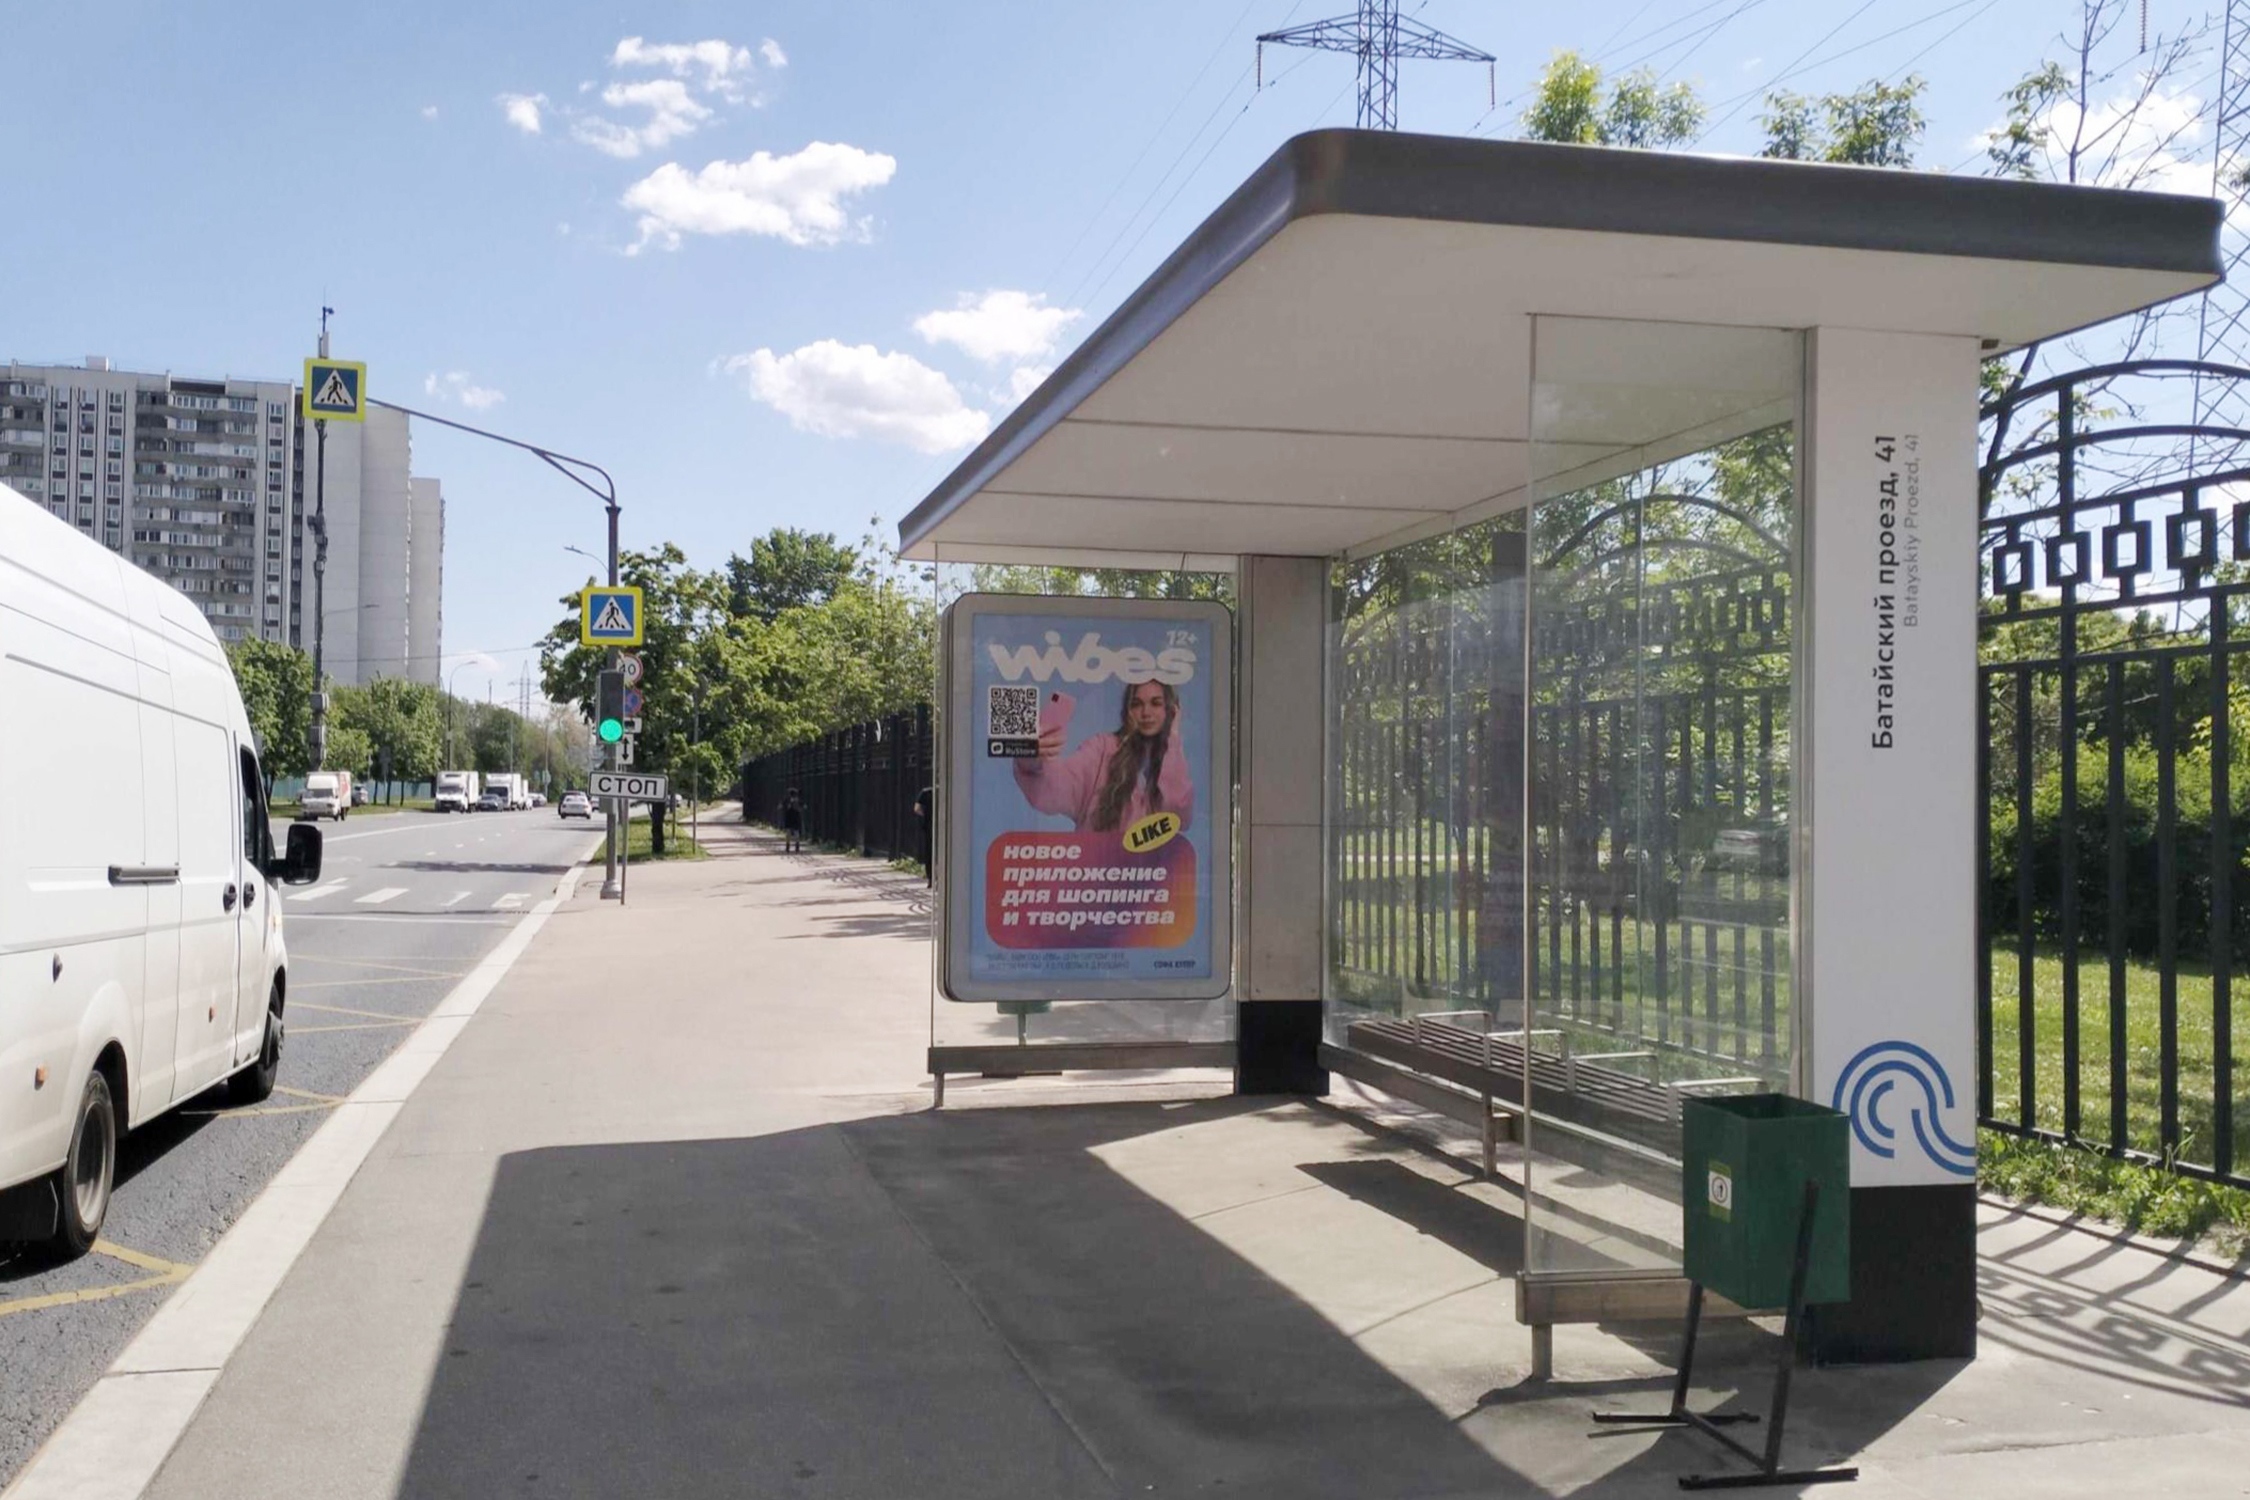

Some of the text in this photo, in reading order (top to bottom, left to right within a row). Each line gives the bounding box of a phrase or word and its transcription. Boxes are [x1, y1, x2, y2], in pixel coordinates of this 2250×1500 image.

[1904, 434, 1922, 627] Batayskiy Proezd, 41
[1872, 435, 1900, 750] Батайский проезд, 41
[1167, 630, 1199, 646] 12+
[988, 630, 1197, 686] wibes
[598, 776, 658, 796] СТОП
[1131, 816, 1172, 848] LIKE
[1003, 844, 1082, 860] новое
[1002, 866, 1167, 887] приложение
[1001, 888, 1170, 907] для шопинга
[1002, 910, 1176, 931] и творчества
